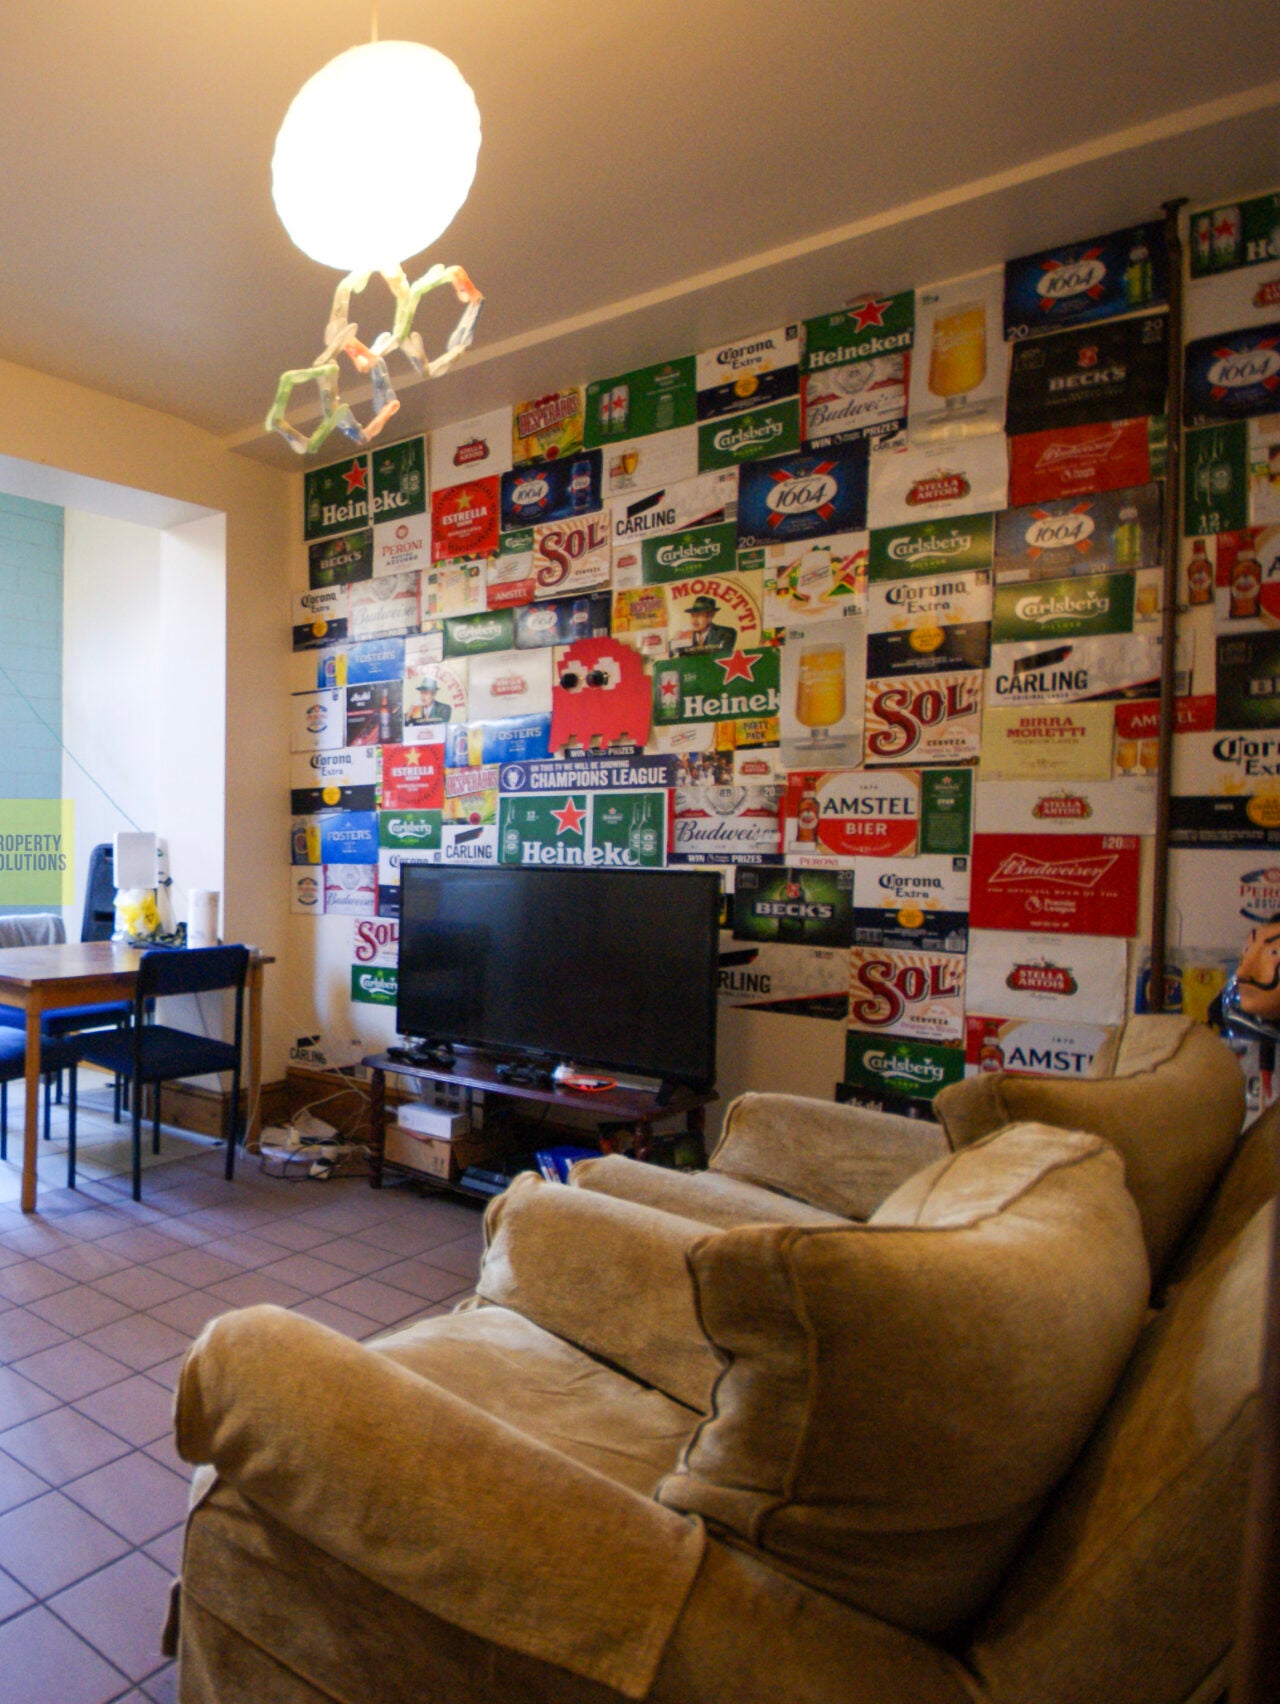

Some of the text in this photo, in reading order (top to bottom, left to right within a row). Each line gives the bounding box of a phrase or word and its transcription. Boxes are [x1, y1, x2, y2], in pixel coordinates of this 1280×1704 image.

[1046, 268, 1096, 294] 1664
[717, 339, 775, 365] Corona
[809, 332, 911, 368] Heineken
[732, 356, 763, 370] Extra
[1220, 358, 1270, 382] 1664
[1049, 366, 1127, 391] BECK'S
[519, 394, 578, 434] DESPERADOS
[714, 420, 784, 450] Carlsberg
[811, 421, 900, 450] WIN PRIZES
[776, 482, 828, 507] 1664
[917, 488, 959, 499] ARTOIS
[919, 480, 959, 492] STELLA
[442, 507, 489, 527] ESTRELLA
[616, 508, 676, 536] CARLING
[1035, 521, 1084, 542] 1664
[381, 540, 423, 557] PERONI
[738, 536, 755, 549] 20
[888, 533, 971, 561] Carlsberg
[537, 523, 607, 588] SOL
[657, 540, 721, 567] Carlsberg
[301, 592, 337, 608] Corona
[495, 588, 528, 602] AMSTEL
[885, 580, 969, 606] Corona
[671, 579, 758, 633] MORETTI
[906, 601, 951, 614] Extra
[1015, 594, 1109, 622] Carlsberg
[996, 671, 1088, 694] CARLING
[744, 719, 770, 731] PARTY
[869, 683, 978, 757] SOL
[1020, 717, 1073, 727] BIRRA
[745, 730, 766, 740] PACK
[1006, 727, 1086, 738] MORETTI
[926, 738, 966, 746] CERVEZA
[310, 753, 352, 769] Corona
[570, 746, 635, 758] WIN PRIZES
[321, 767, 344, 776] Extra
[392, 766, 434, 776] ESTRELLA
[540, 763, 553, 771] THIS
[555, 763, 562, 771] TV
[563, 763, 573, 771] WE
[574, 762, 590, 770] WILL
[591, 761, 598, 769] BE
[600, 760, 629, 768] SHOWING
[530, 767, 667, 788] CHAMPIONS LEAGUE
[764, 786, 776, 797] 20
[823, 797, 915, 816] AMSTEL
[1043, 800, 1081, 808] STELLA
[388, 818, 432, 838] Carlsberg
[845, 822, 888, 835] BIER
[446, 845, 493, 860] CARLING
[688, 854, 762, 864] WIN PRIZES
[800, 857, 839, 866] PERONI
[1003, 859, 1105, 878] Budweiser
[878, 873, 944, 890] Corona
[895, 887, 929, 898] Extra
[754, 901, 833, 918] BECK'S
[356, 921, 399, 961] SOL
[360, 973, 397, 992] Carlsber
[718, 970, 771, 993] RLING
[1018, 978, 1065, 989] ARTOIS
[1019, 970, 1064, 981] STELLA
[853, 961, 960, 1028] SOL
[910, 1015, 949, 1025] CERVEZA
[863, 1051, 945, 1082] Carlsberg
[1009, 1048, 1094, 1073] AMST
